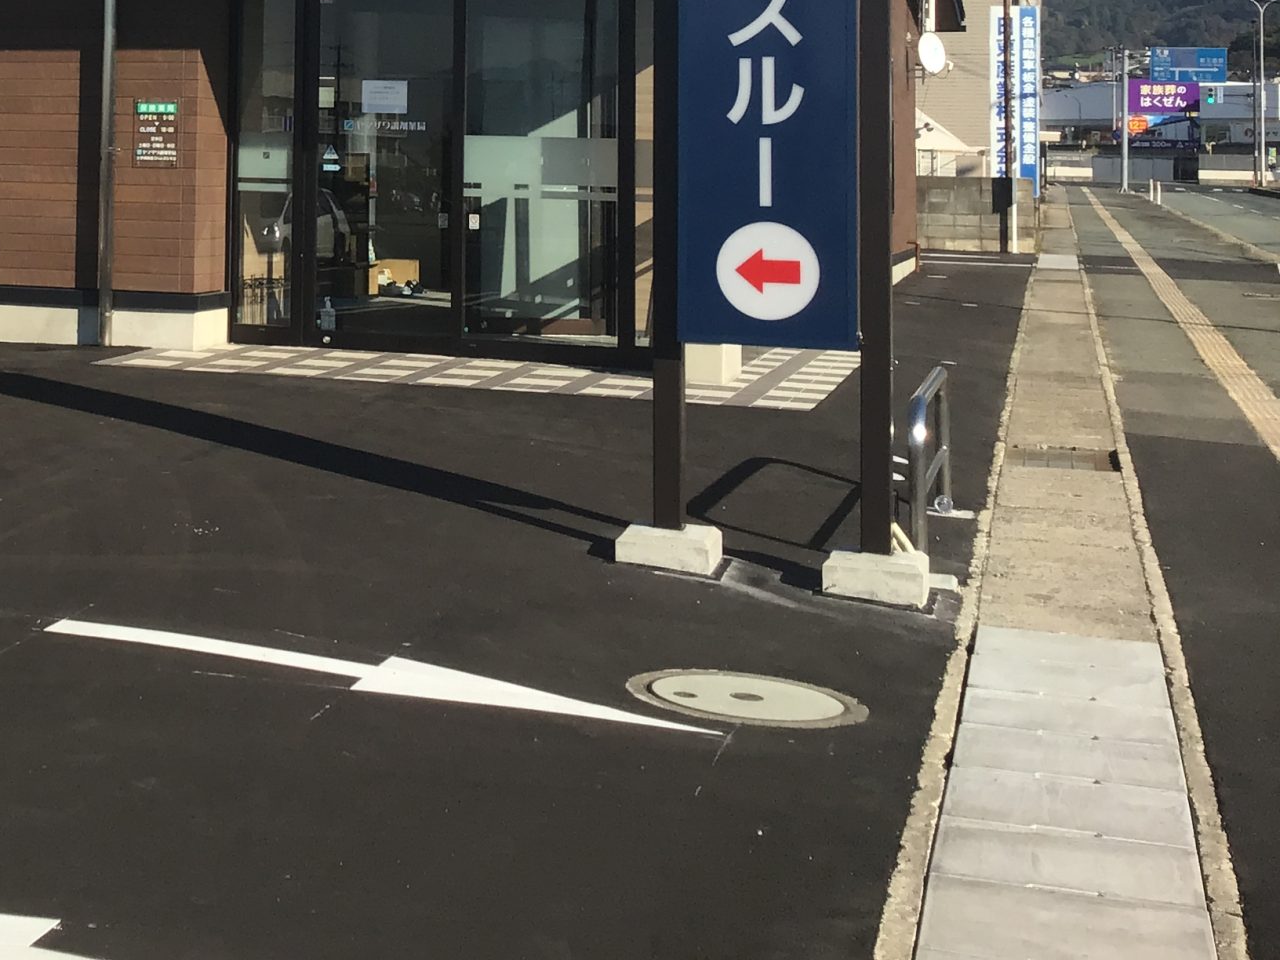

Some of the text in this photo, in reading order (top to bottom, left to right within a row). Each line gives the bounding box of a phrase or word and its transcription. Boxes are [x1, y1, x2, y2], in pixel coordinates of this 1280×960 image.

[1140, 84, 1187, 96] 家族葬の
[1140, 96, 1187, 108] はくぜん
